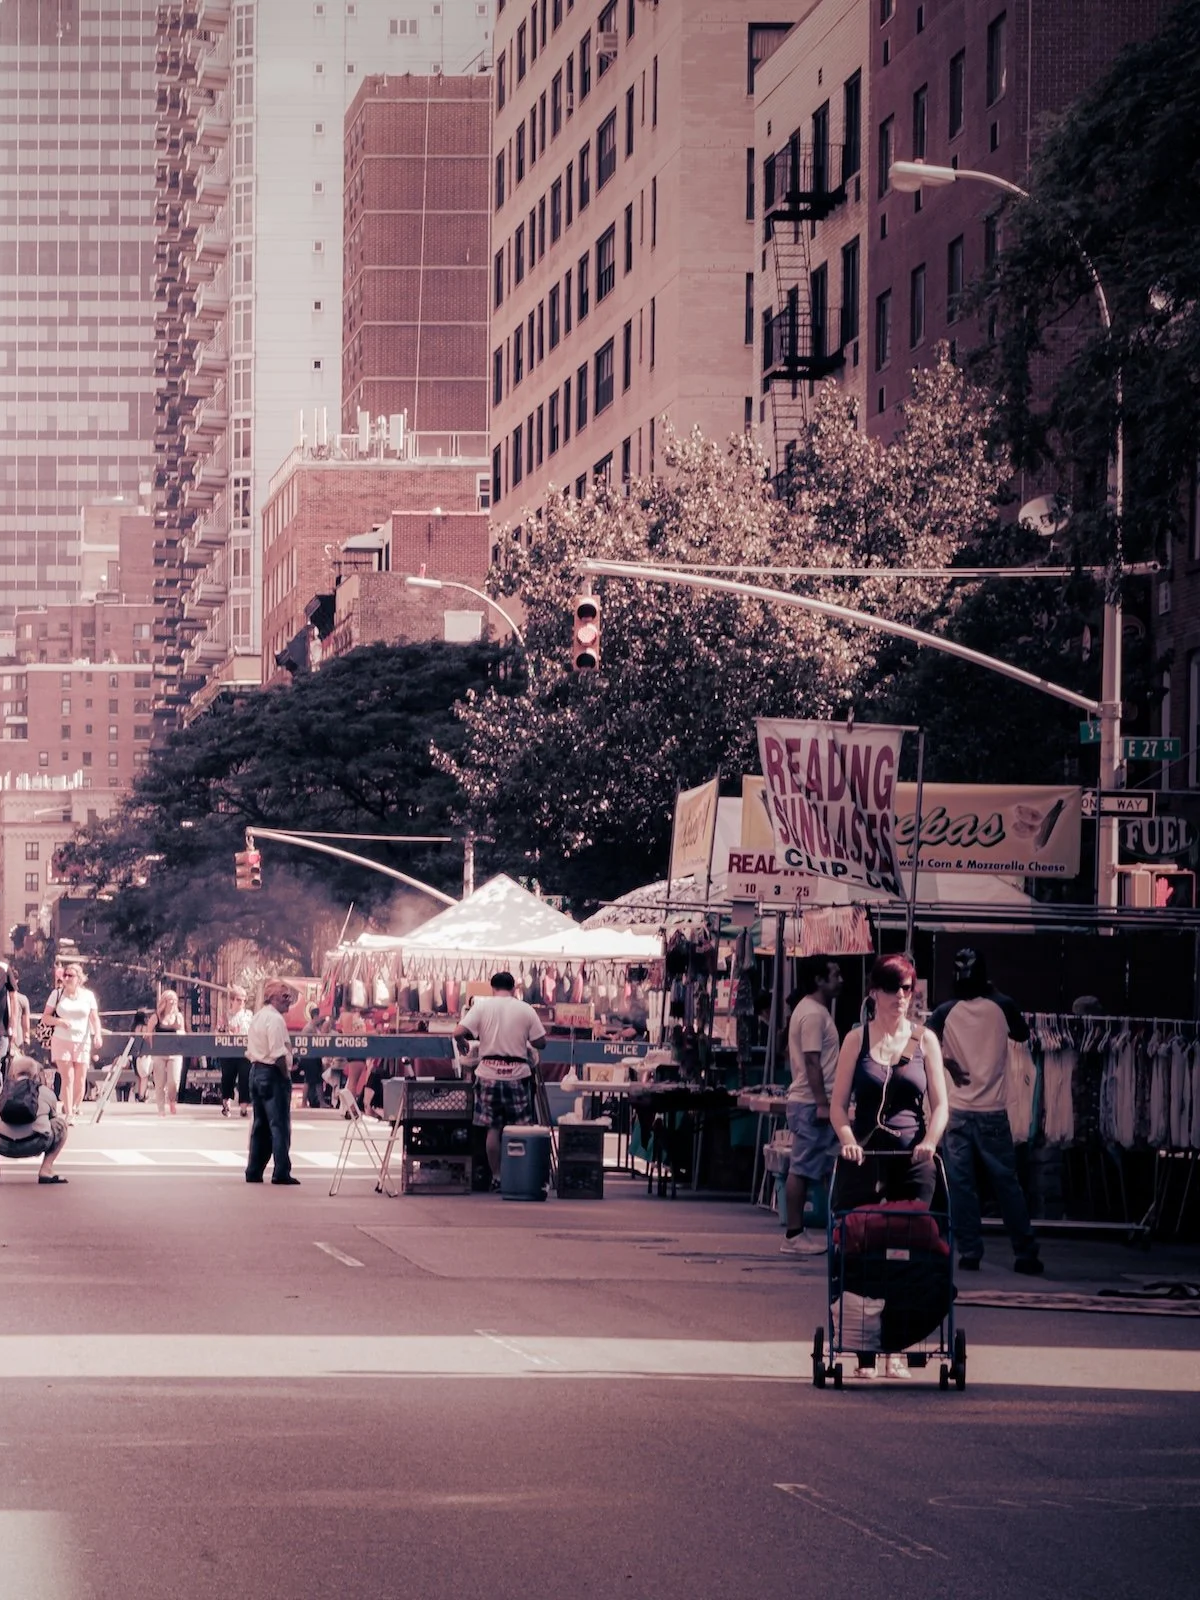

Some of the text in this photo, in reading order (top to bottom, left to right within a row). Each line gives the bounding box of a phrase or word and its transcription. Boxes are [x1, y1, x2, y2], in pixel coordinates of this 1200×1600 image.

[1128, 740, 1136, 758] E
[1142, 740, 1158, 758] 27
[1117, 799, 1143, 810] WAY
[895, 807, 1006, 858] epas
[1125, 816, 1193, 855] FUEL
[728, 853, 814, 877] READ
[899, 859, 1066, 872] wet Corn & Mozzarella Cheese
[774, 885, 781, 895] 3
[214, 1036, 249, 1047] POLICE
[295, 1036, 368, 1048] DO NOT CROSS
[603, 1044, 638, 1055] POLICE
